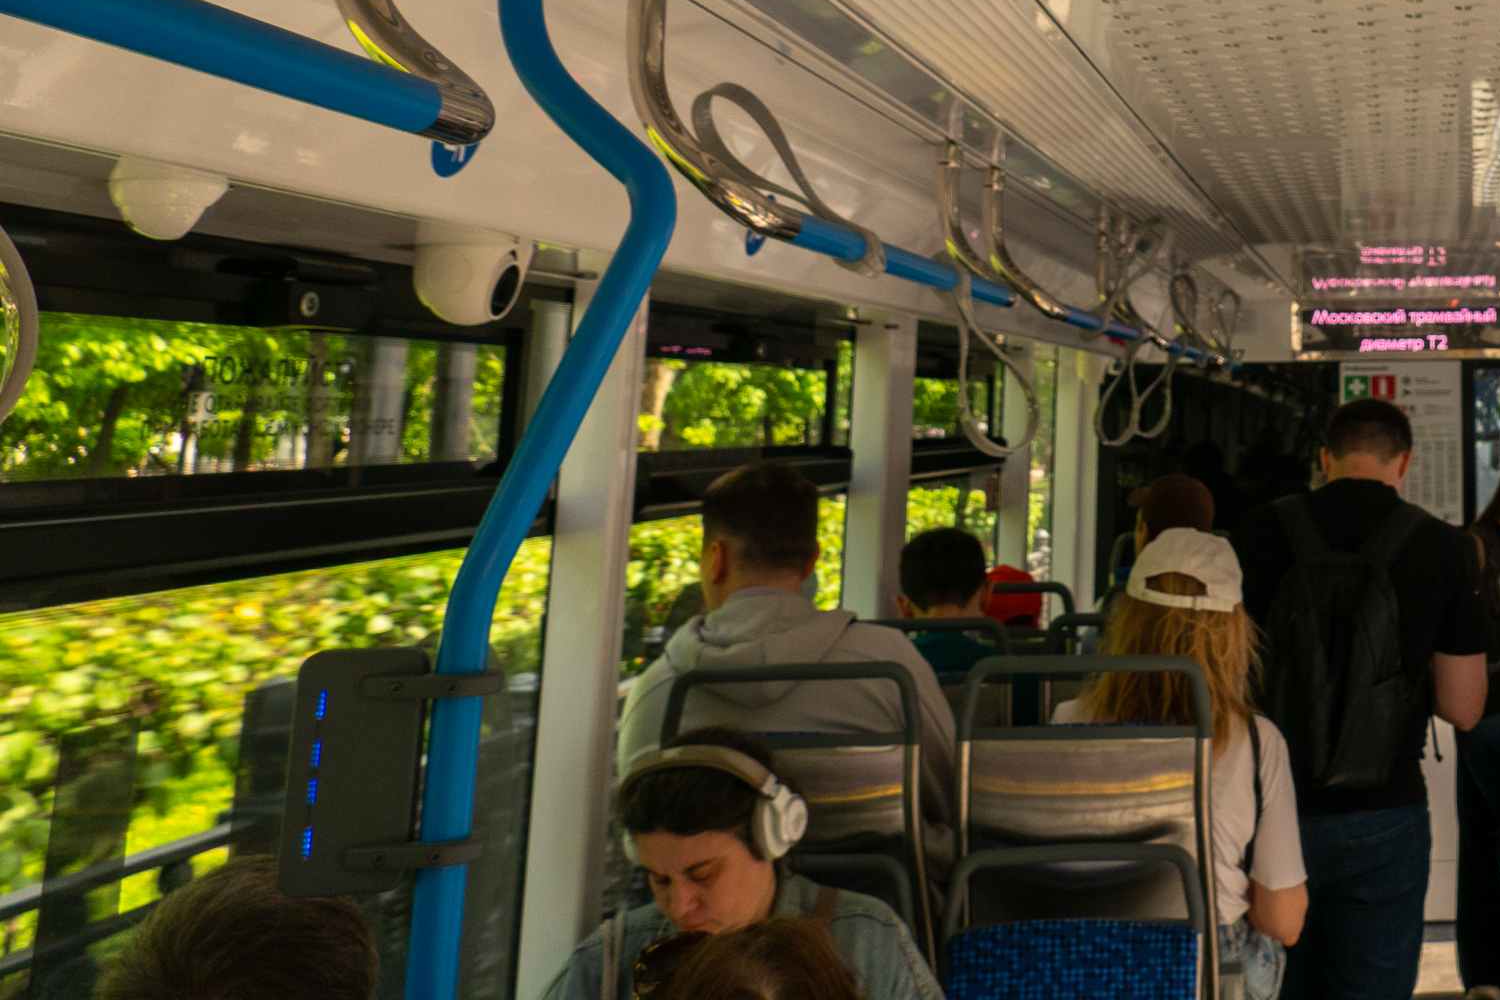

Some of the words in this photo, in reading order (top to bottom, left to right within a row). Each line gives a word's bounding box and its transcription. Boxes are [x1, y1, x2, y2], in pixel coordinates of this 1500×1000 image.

[1311, 309, 1406, 325] Московский
[1408, 307, 1497, 326] трамвайный
[1359, 337, 1424, 352] диаметр
[1427, 334, 1449, 350] Т2
